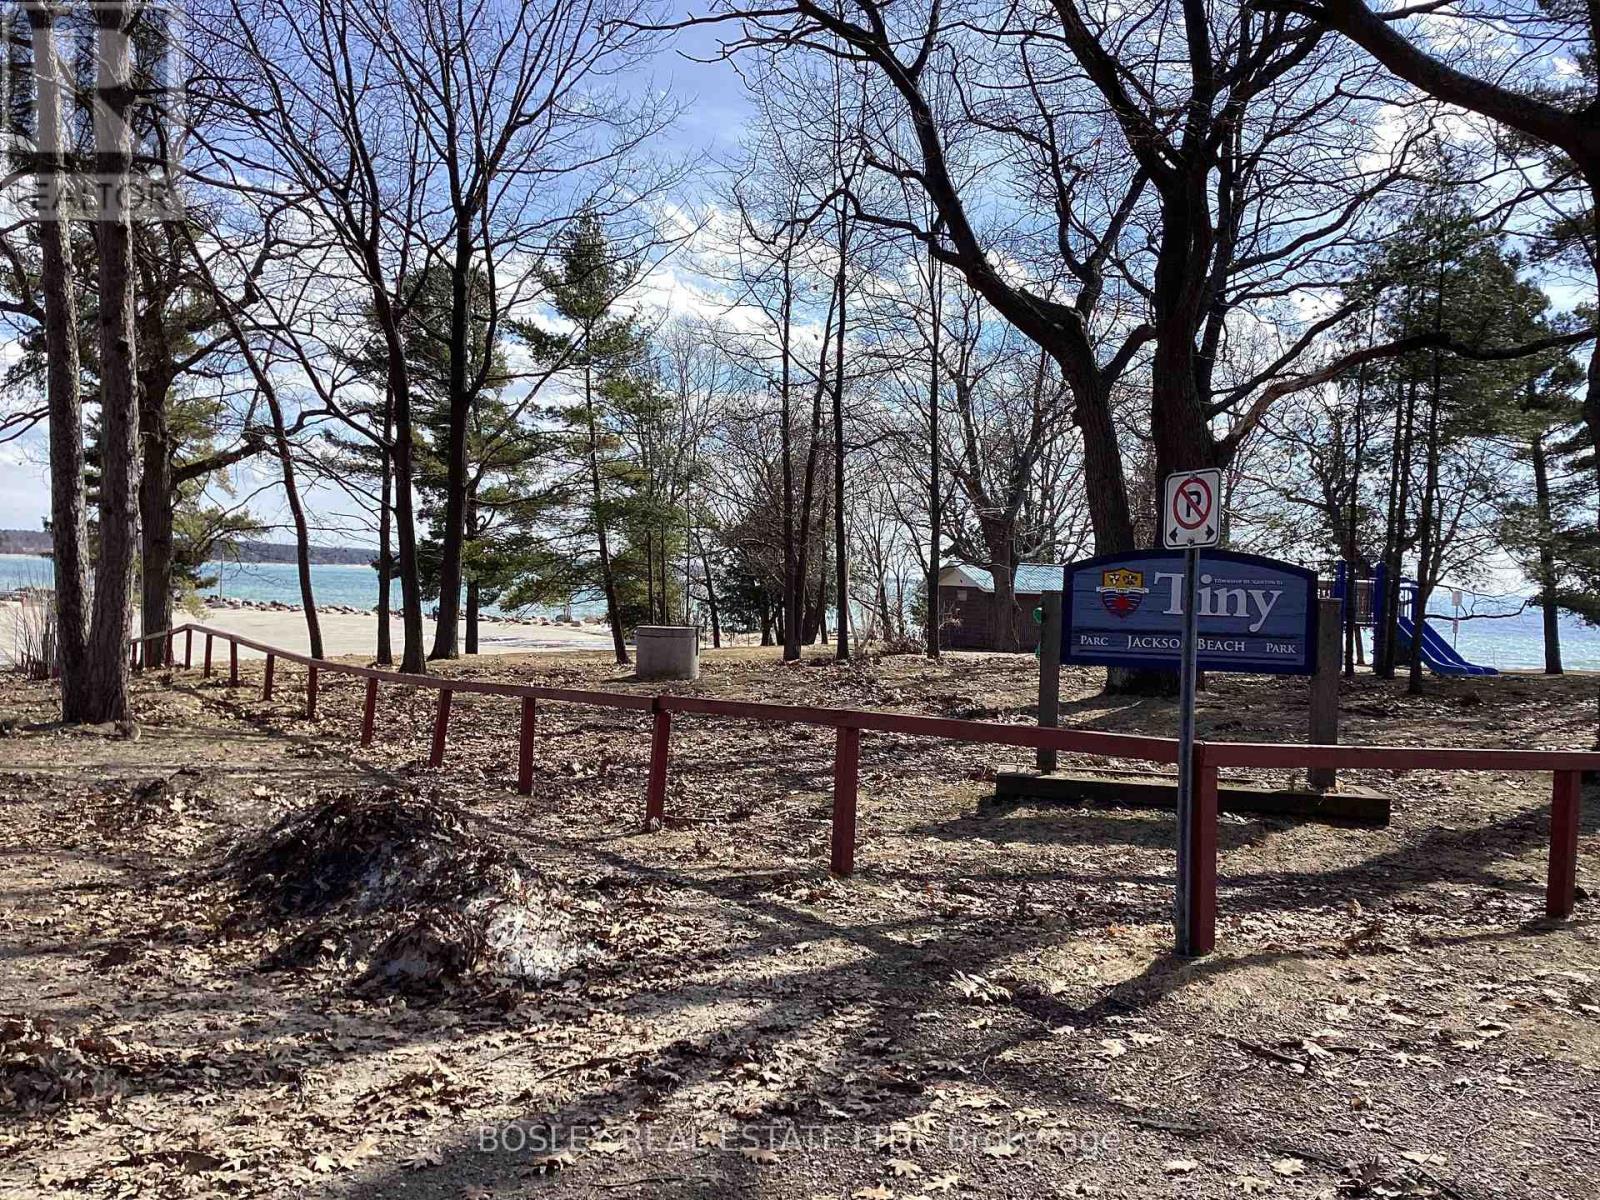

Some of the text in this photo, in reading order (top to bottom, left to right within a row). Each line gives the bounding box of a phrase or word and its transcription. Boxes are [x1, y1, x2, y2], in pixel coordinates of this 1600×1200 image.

[1186, 490, 1202, 518] P
[1154, 571, 1283, 632] Tiny
[1079, 634, 1297, 654] PARC JACKSO BEACH PARK
